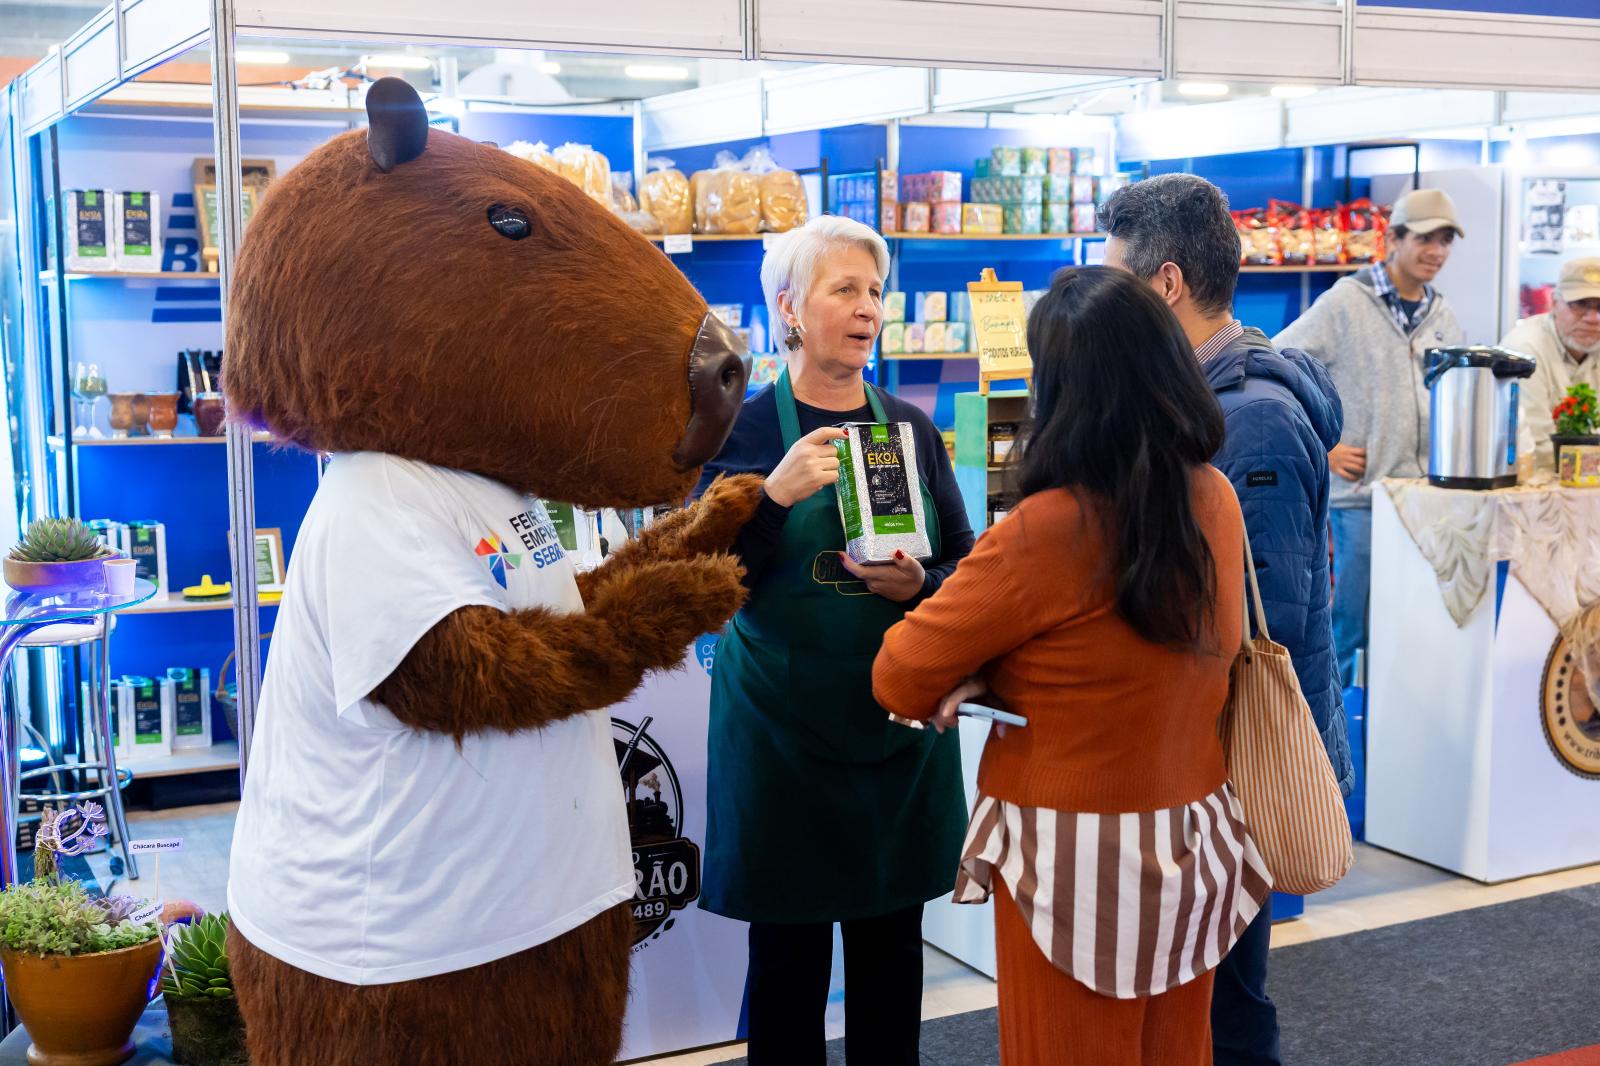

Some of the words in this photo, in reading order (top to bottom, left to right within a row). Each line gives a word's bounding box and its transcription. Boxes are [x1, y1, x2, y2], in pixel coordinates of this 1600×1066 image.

[509, 511, 544, 533] FEIR
[520, 523, 557, 551] EMPR
[533, 542, 565, 569] SEBR
